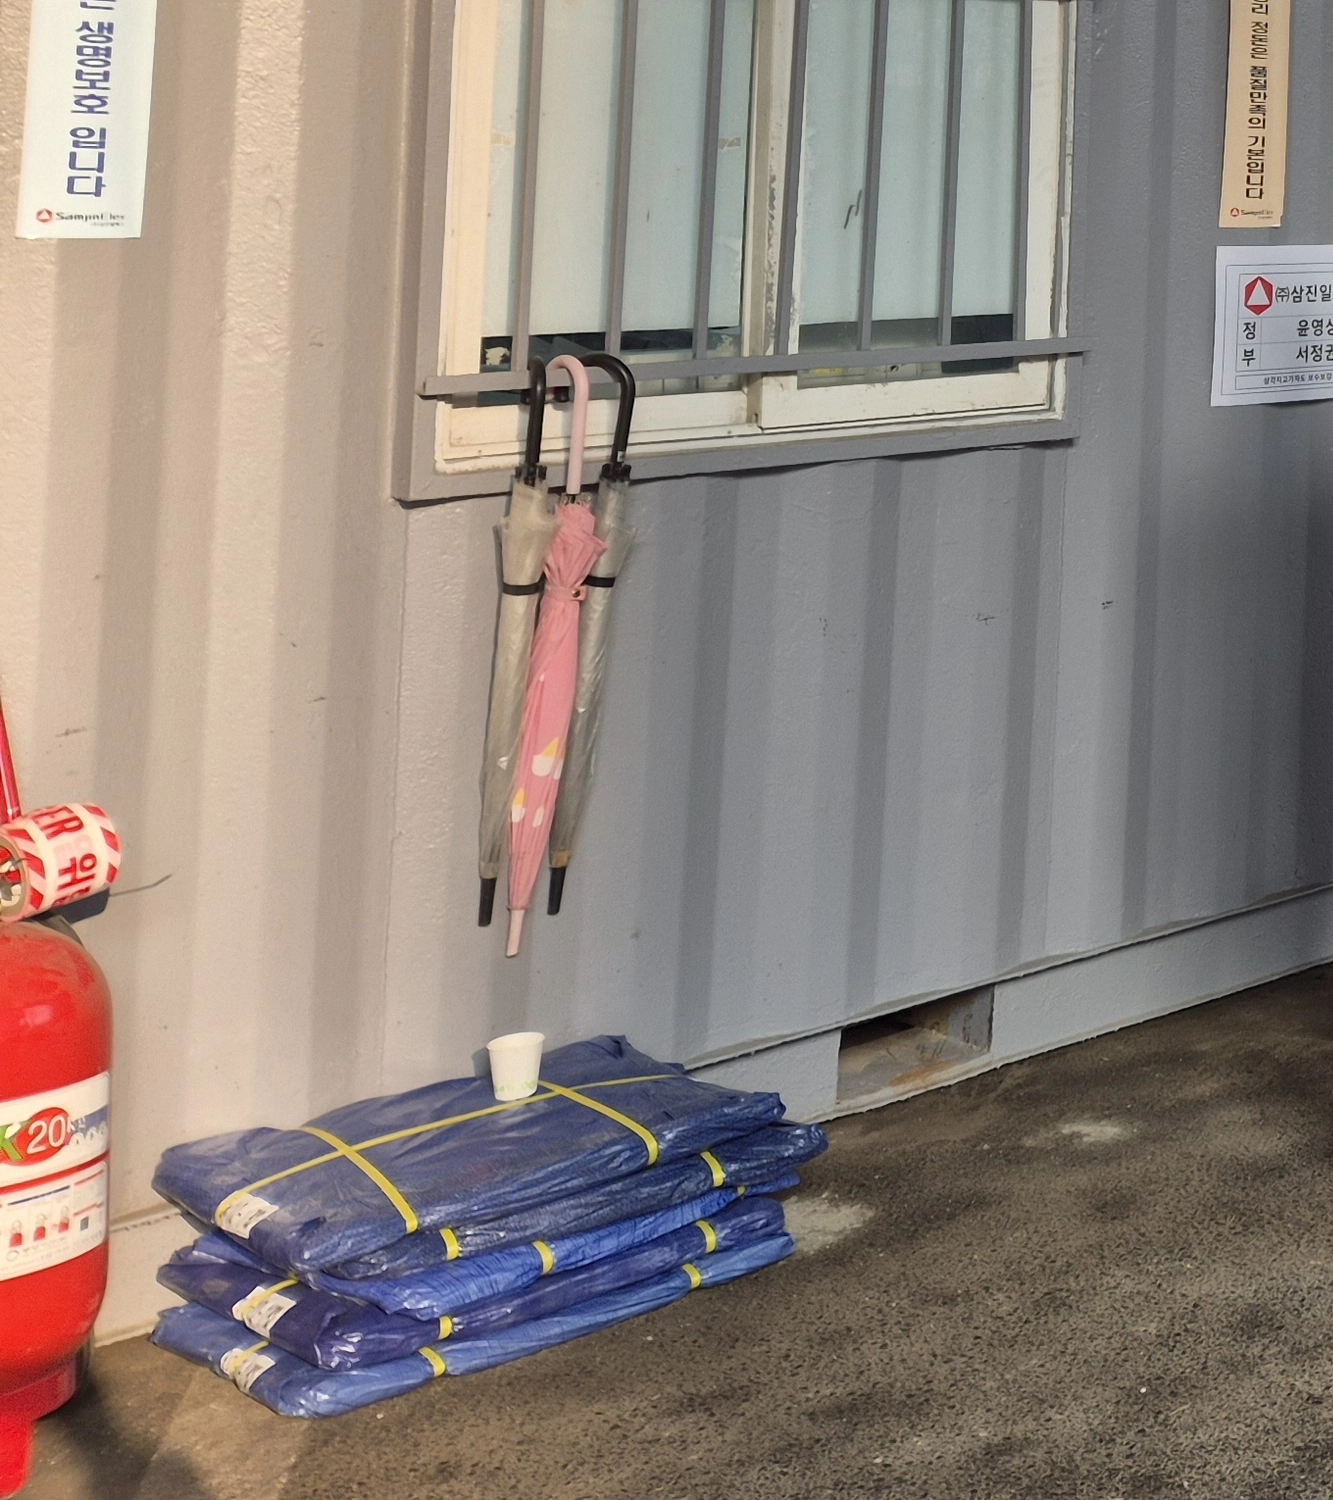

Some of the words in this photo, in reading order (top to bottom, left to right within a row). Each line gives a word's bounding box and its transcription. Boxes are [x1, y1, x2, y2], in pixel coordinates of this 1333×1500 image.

[70, 20, 115, 116] 생명보호
[1249, 20, 1269, 60] 정돈은
[1248, 65, 1268, 130] 품질만족의
[65, 125, 108, 199] 입니다
[1245, 135, 1265, 200] 기본입니다
[1241, 348, 1257, 367] 부
[1242, 321, 1257, 340] 정
